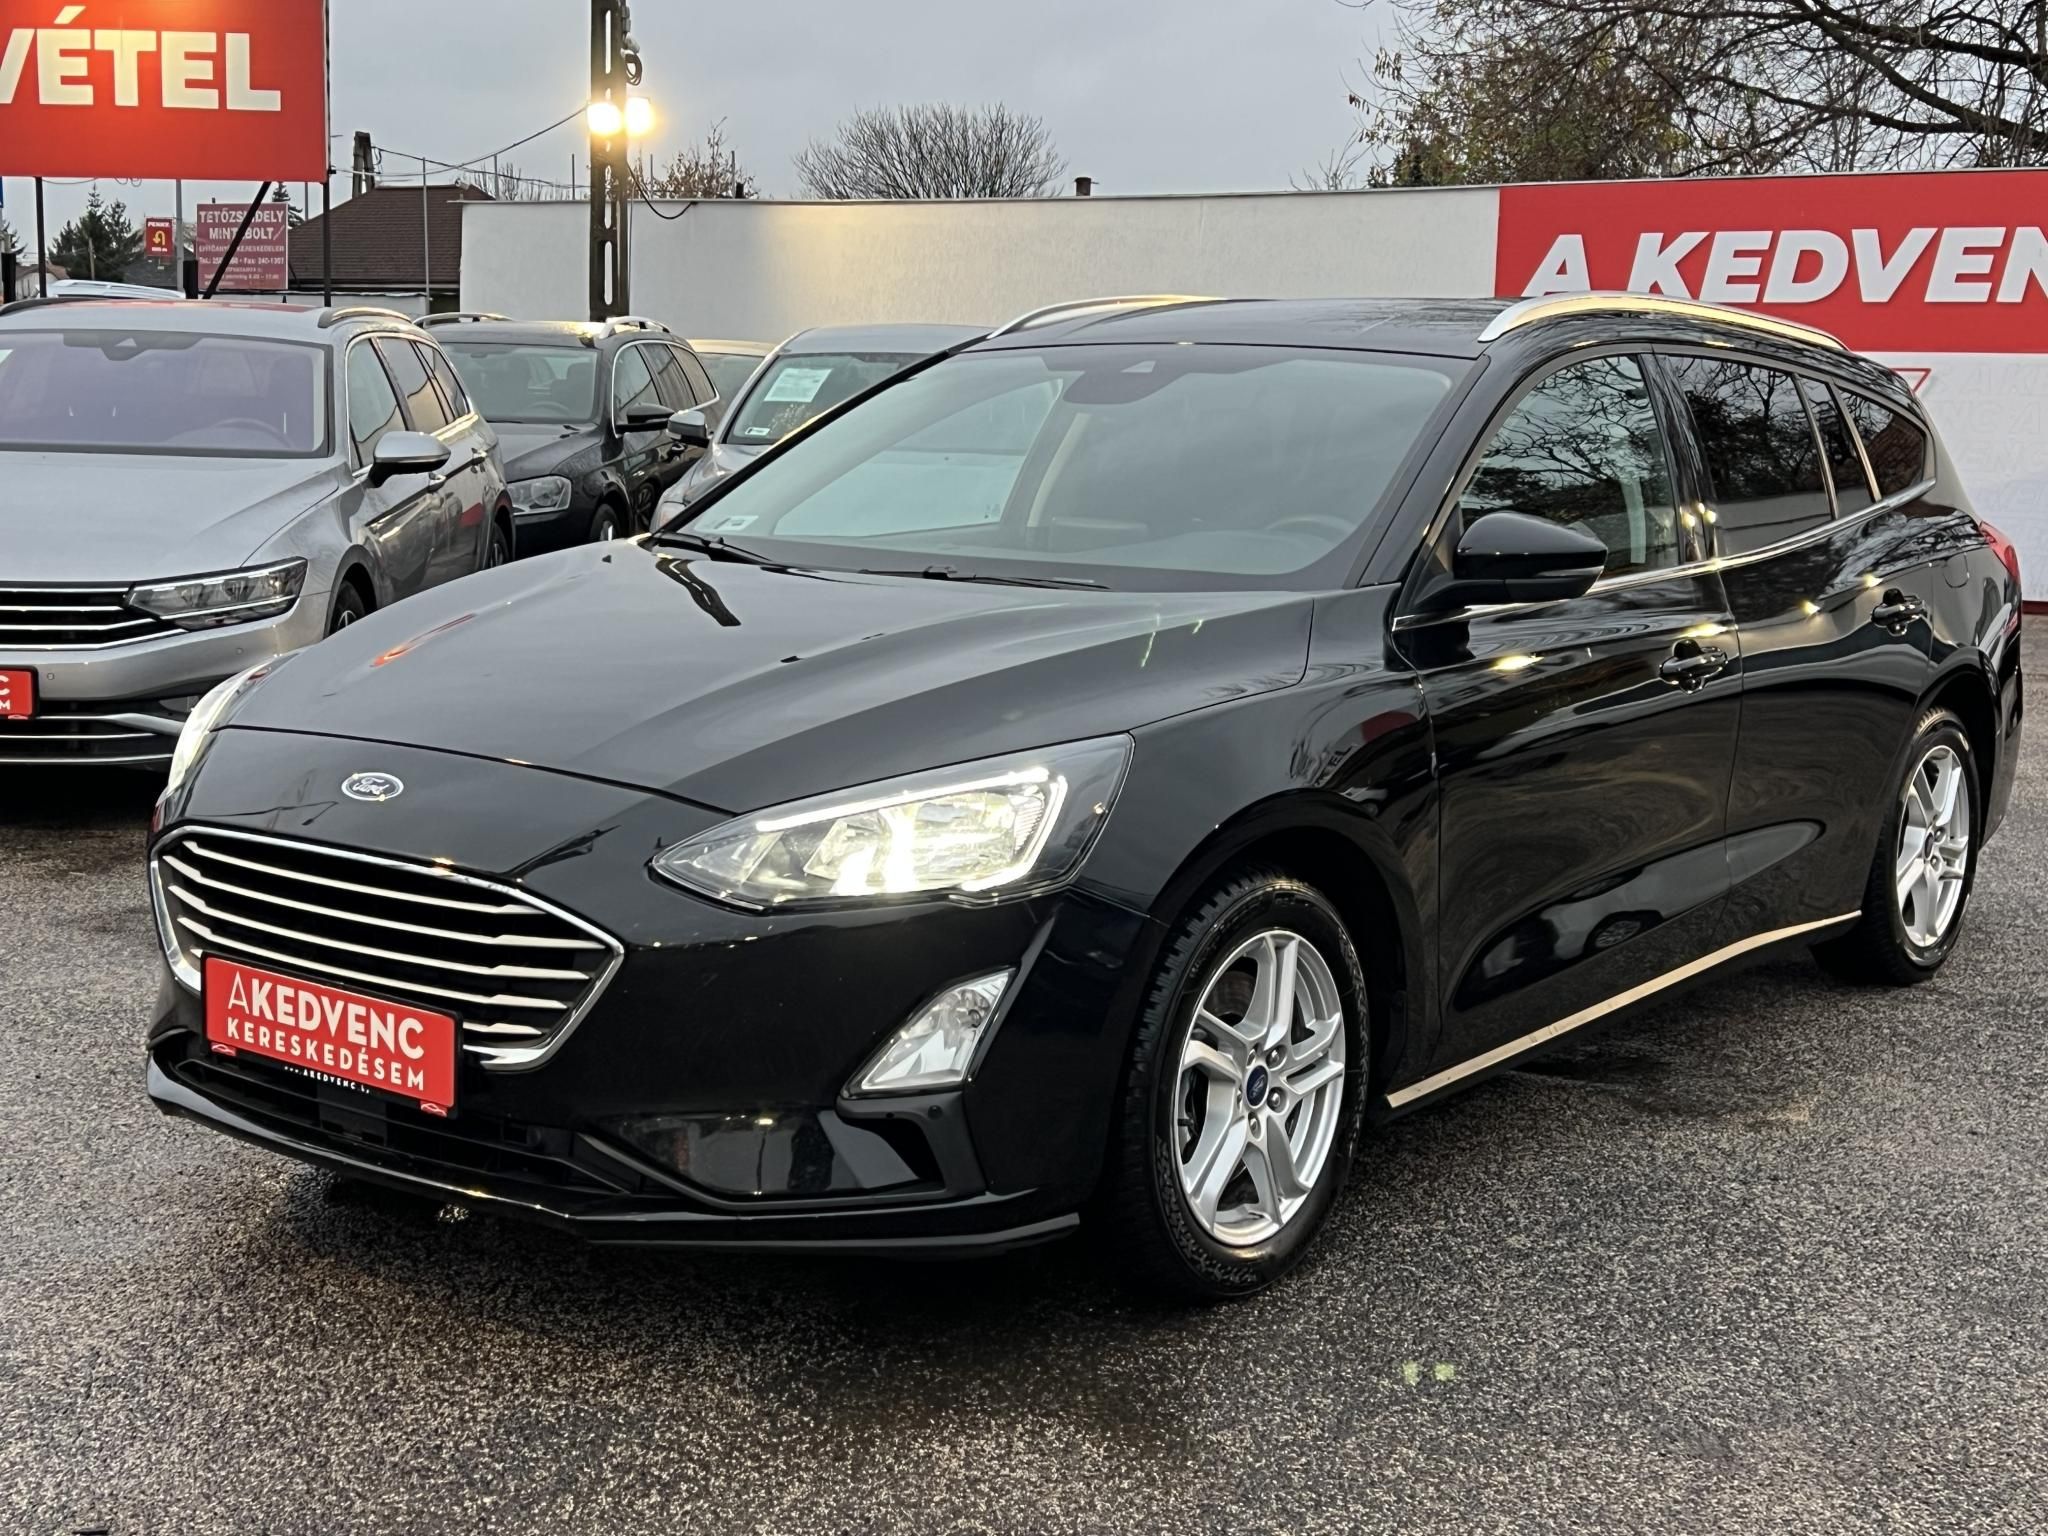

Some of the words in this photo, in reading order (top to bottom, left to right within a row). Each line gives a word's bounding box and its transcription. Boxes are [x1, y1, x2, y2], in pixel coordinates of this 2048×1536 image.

[199, 207, 284, 223] TETŐZSDELY
[209, 227, 274, 240] MINTBOLT
[1520, 234, 1590, 297] A
[227, 1017, 424, 1091] KERESKEDÉSEM
